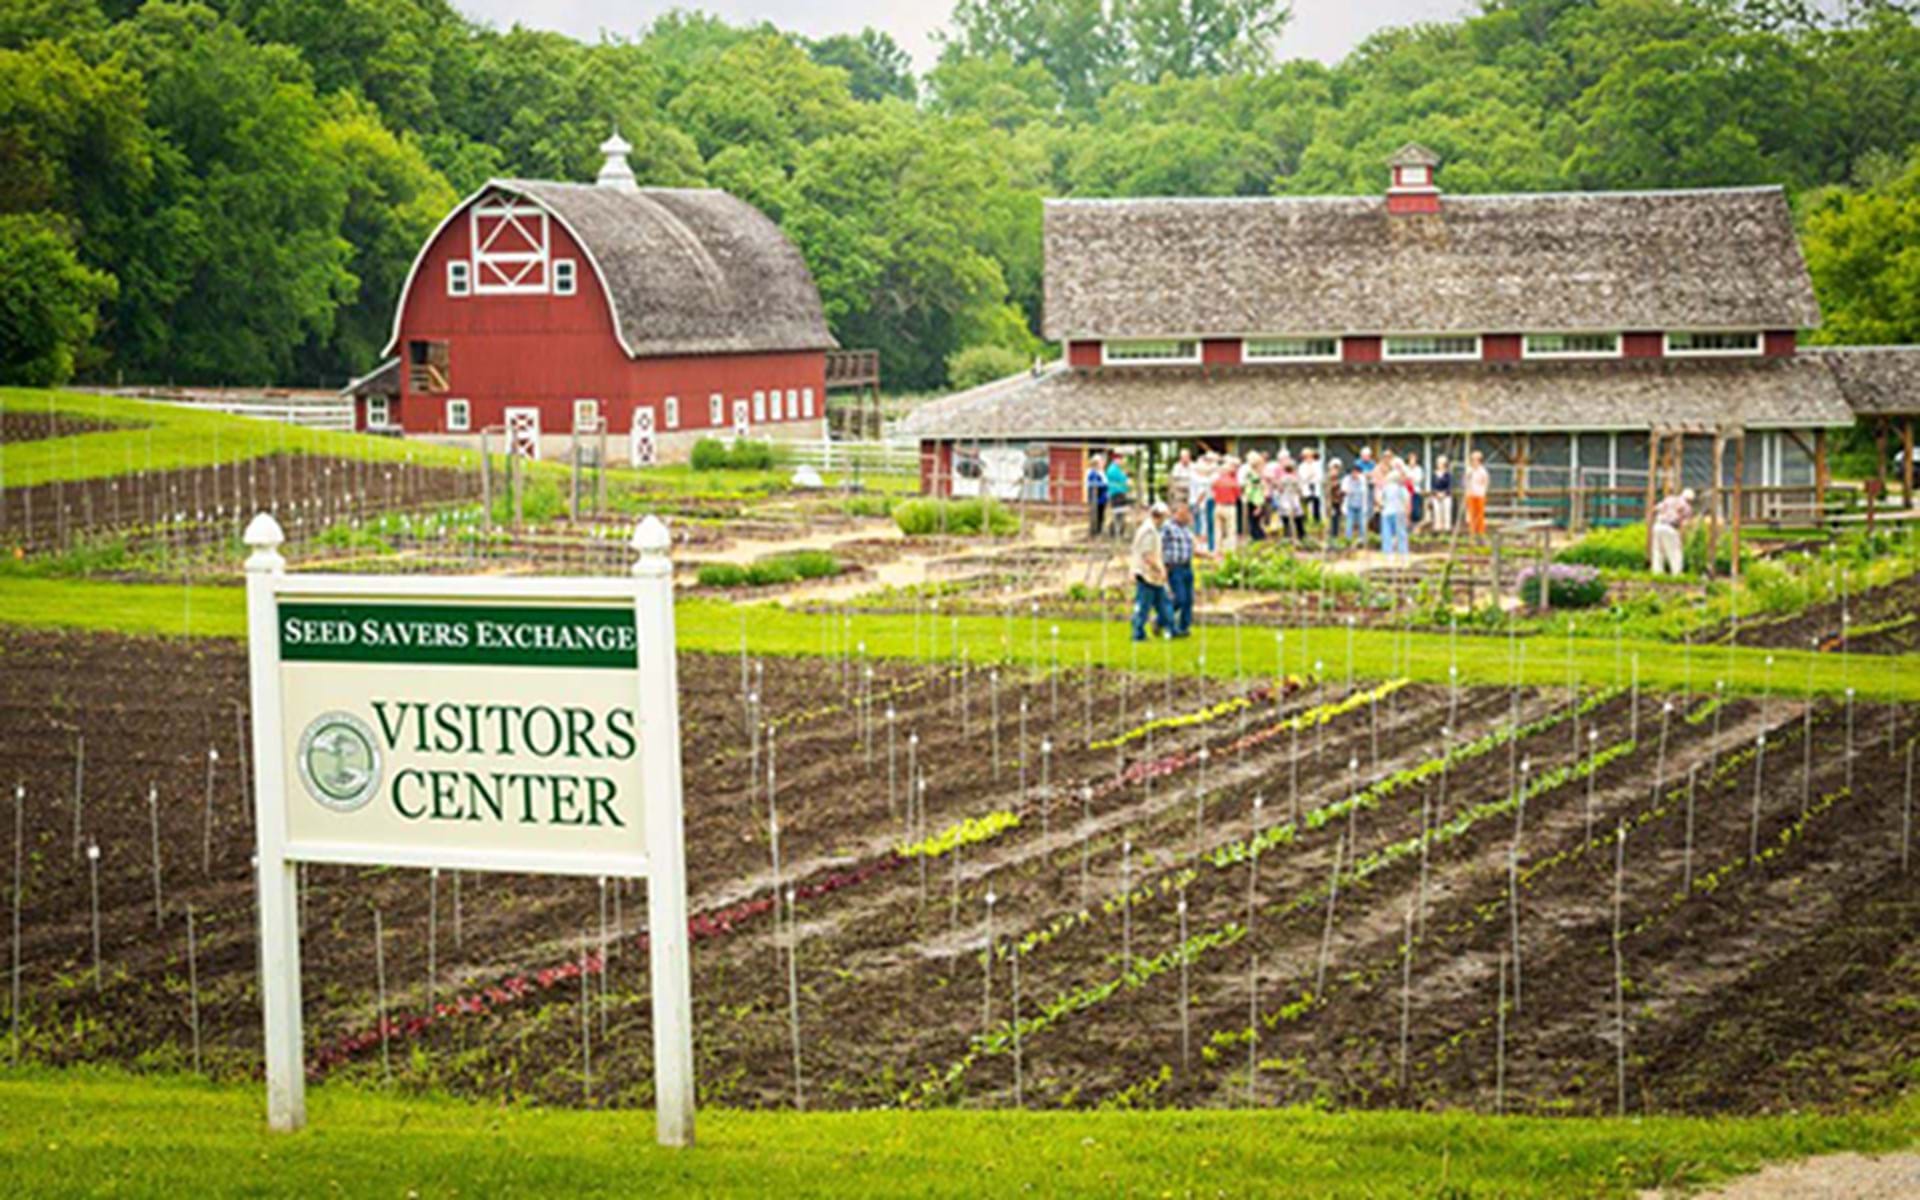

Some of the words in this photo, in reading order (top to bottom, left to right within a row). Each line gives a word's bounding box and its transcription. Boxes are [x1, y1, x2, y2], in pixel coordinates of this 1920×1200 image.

[285, 618, 356, 645] SEED
[361, 620, 469, 647] SAVERS
[475, 621, 637, 651] EXCHANGE
[372, 701, 637, 760] VISITORS
[391, 769, 625, 827] CENTER
